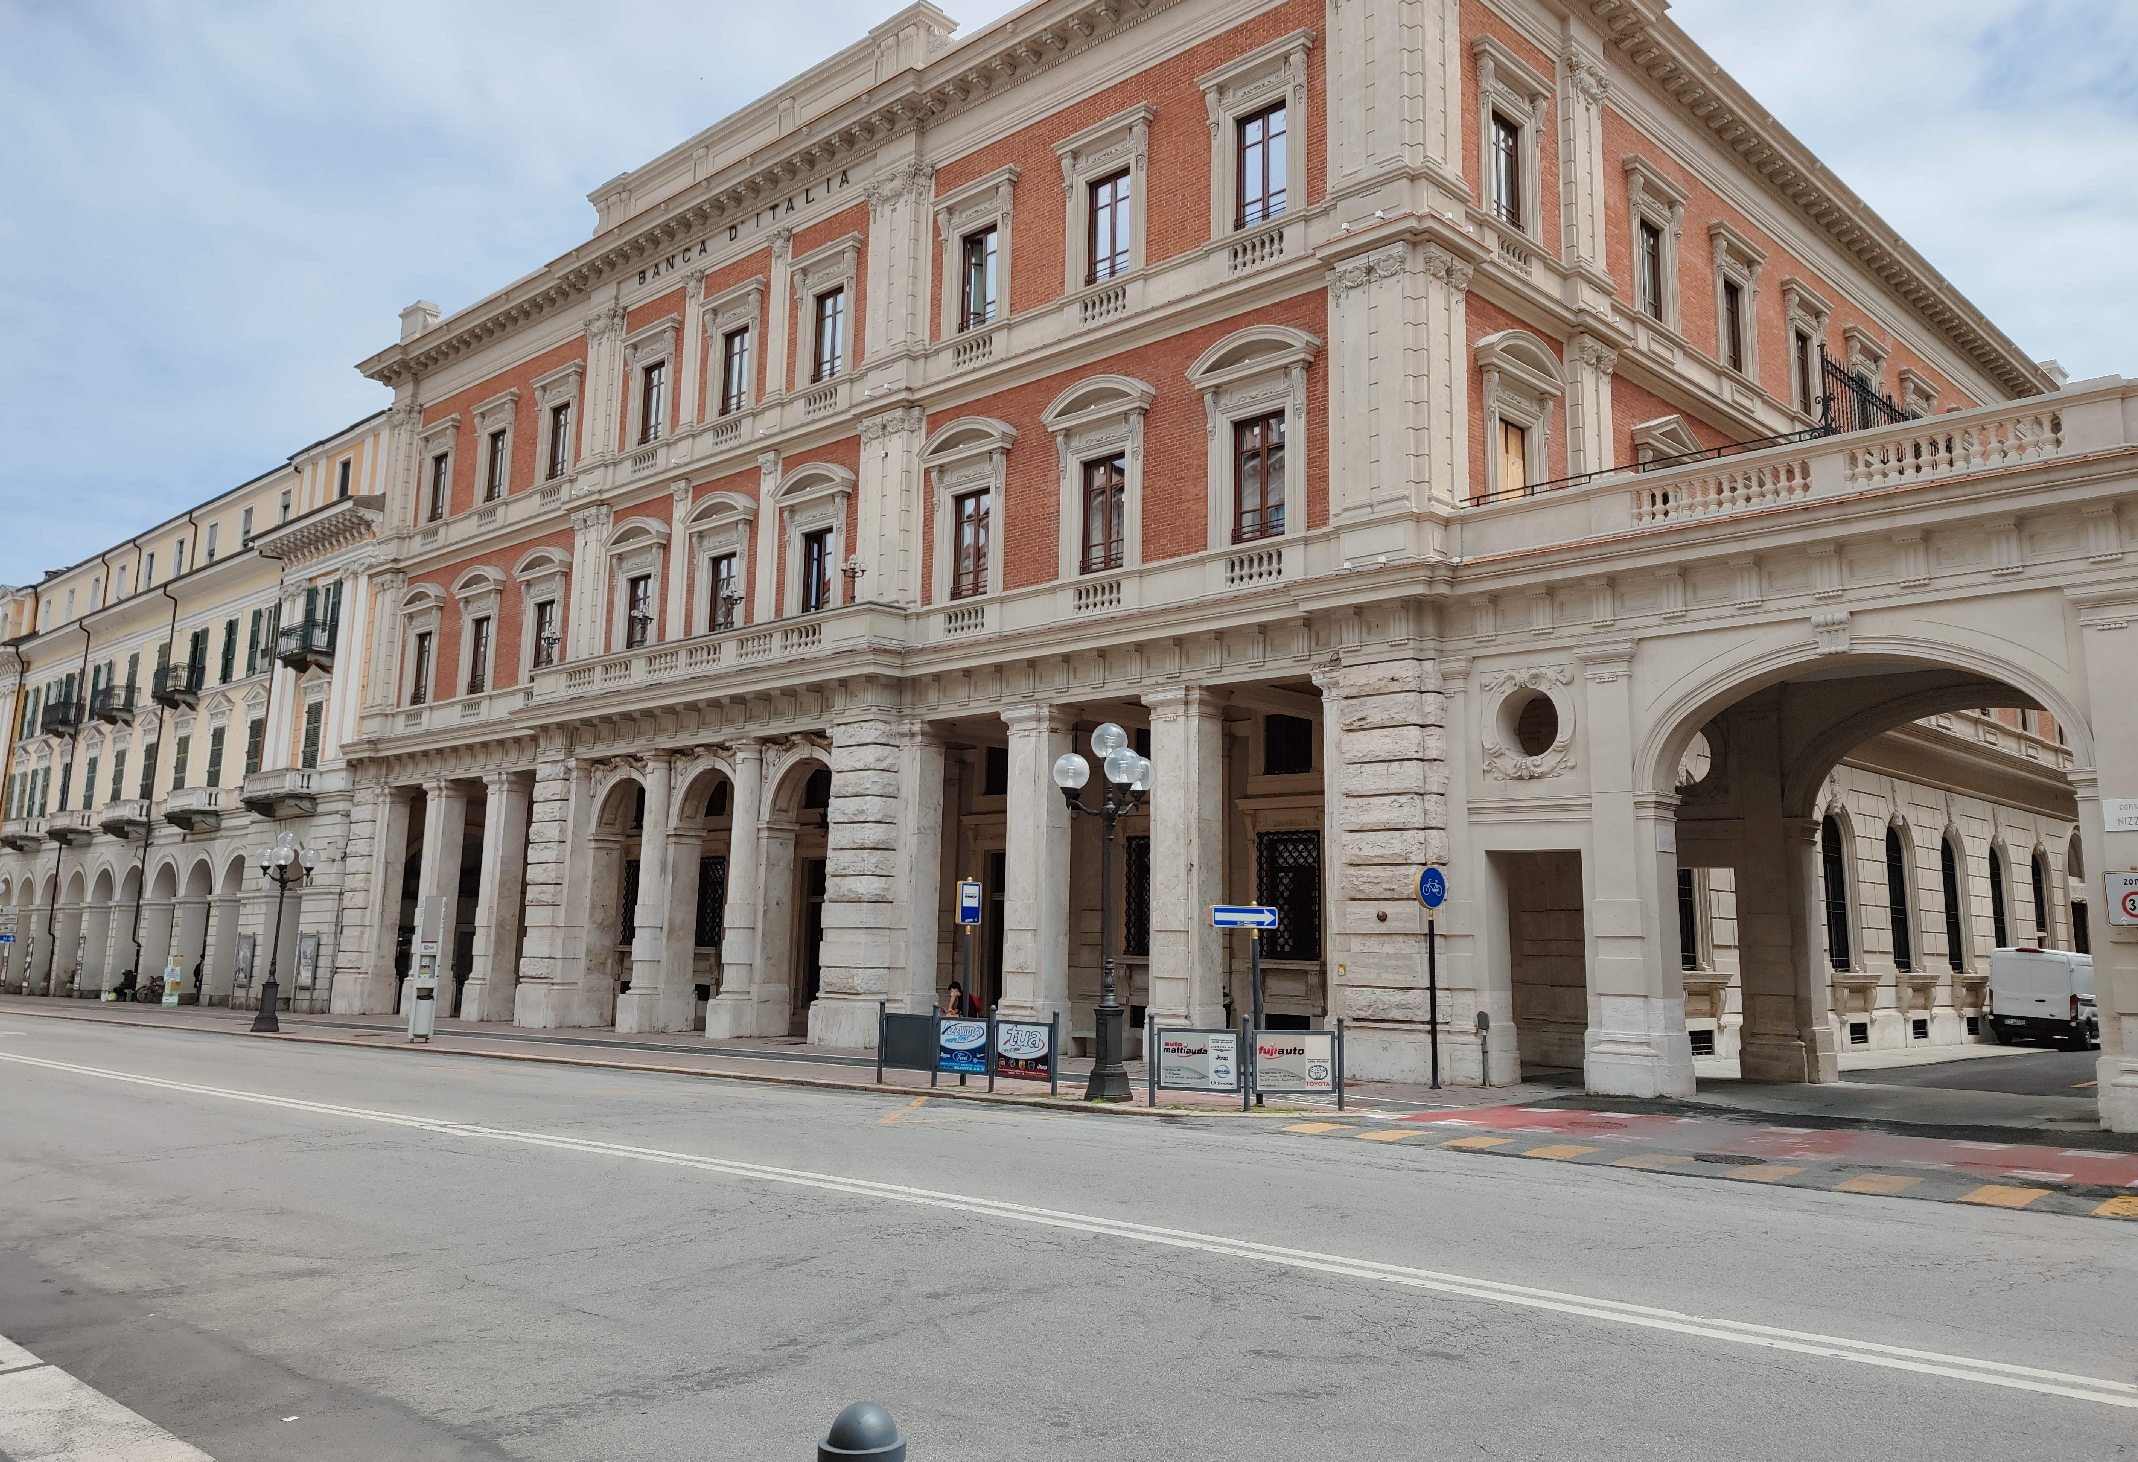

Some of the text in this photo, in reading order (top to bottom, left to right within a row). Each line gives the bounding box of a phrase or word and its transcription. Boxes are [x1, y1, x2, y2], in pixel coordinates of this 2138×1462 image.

[638, 170, 850, 286] BANCA D'ITALIA
[1006, 1025, 1041, 1048] tua
[1163, 1046, 1208, 1055] mattiauda
[1258, 1046, 1304, 1056] fujiauto
